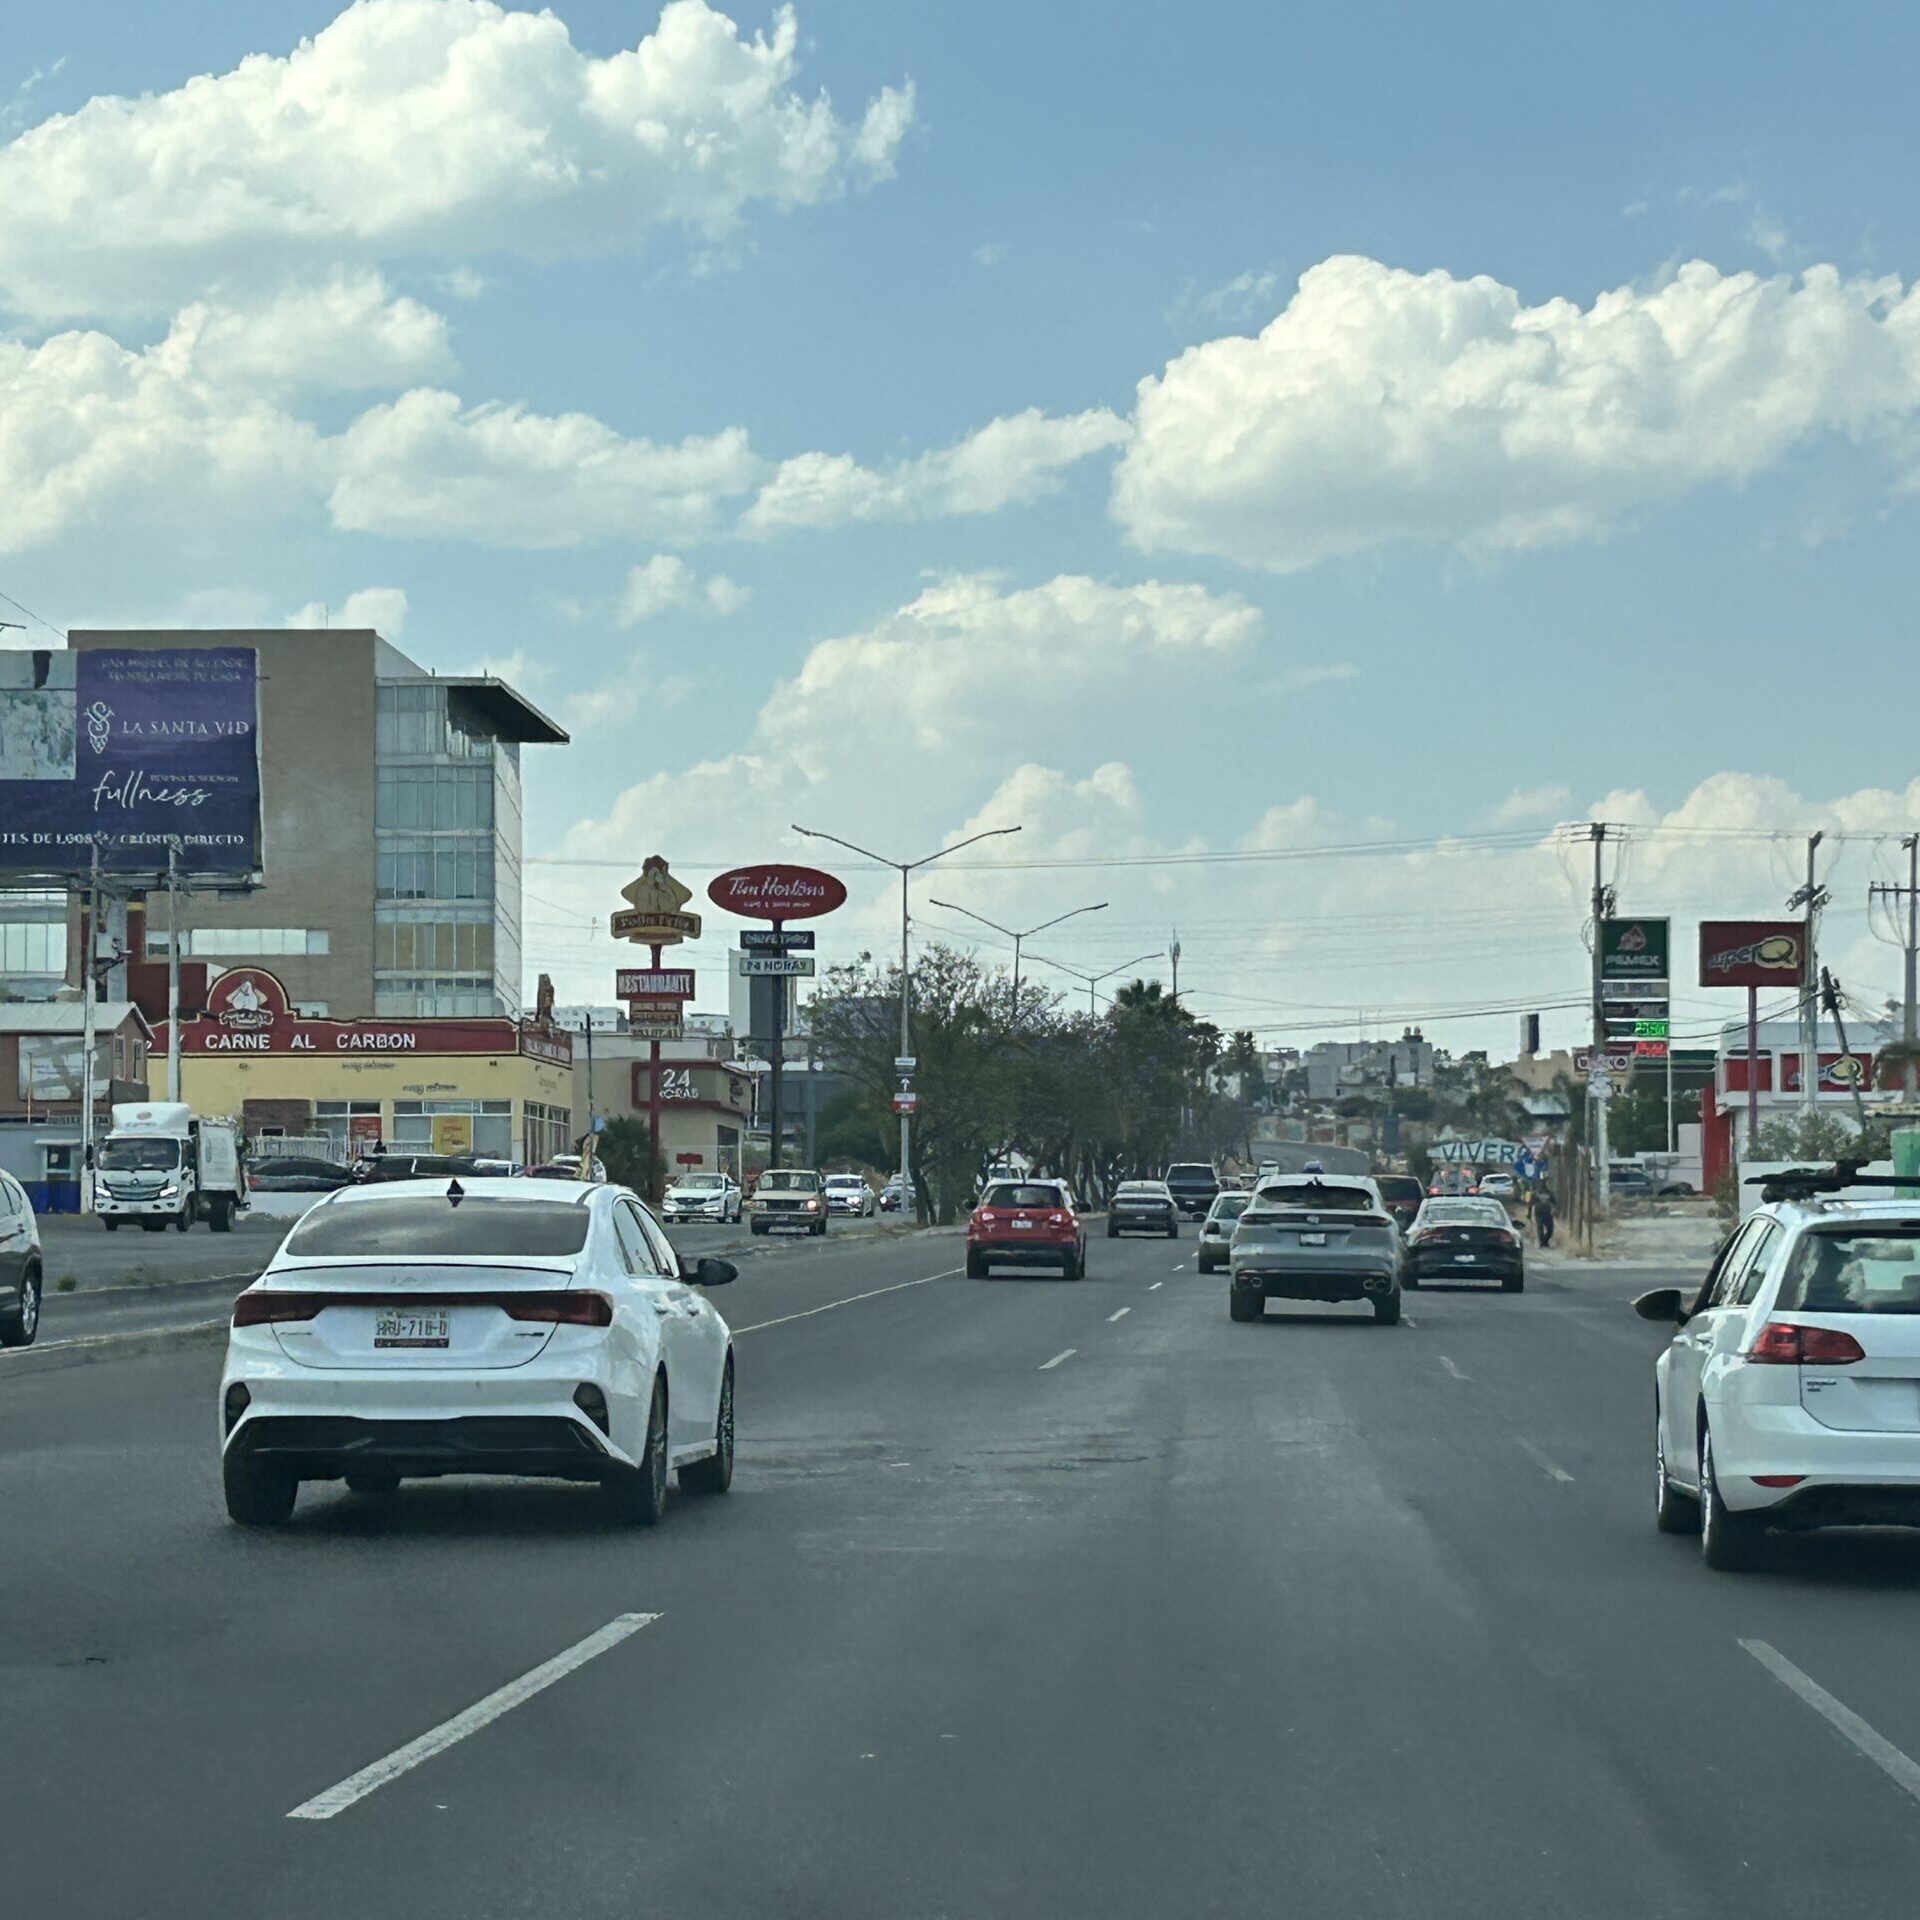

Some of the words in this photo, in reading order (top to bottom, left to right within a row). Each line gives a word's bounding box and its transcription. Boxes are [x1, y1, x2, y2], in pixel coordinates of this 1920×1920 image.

[122, 721, 143, 735] LA
[150, 720, 208, 735] SANTA
[214, 720, 250, 735] VID
[92, 770, 212, 812] fullness
[33, 832, 53, 844] DE
[729, 876, 758, 896] Tim
[760, 875, 825, 897] Hortons
[764, 960, 807, 971] HORAS
[1605, 954, 1659, 966] PEMEX
[204, 1033, 272, 1050] CARNE
[291, 1033, 317, 1050] AL
[336, 1033, 416, 1050] CARBON
[662, 1068, 690, 1088] 24
